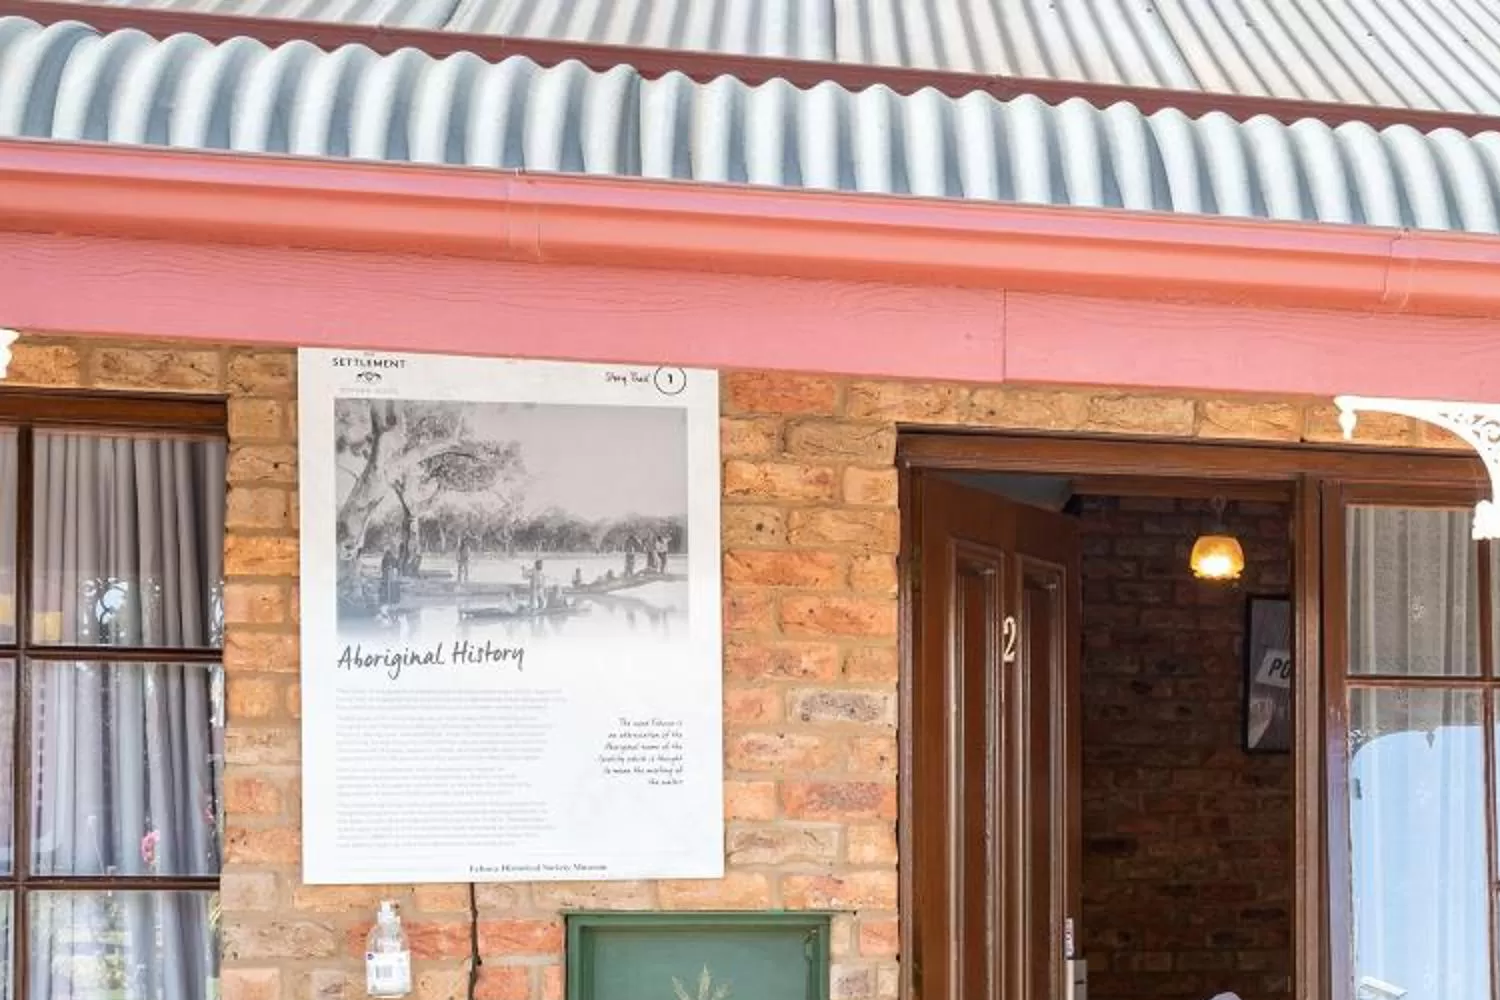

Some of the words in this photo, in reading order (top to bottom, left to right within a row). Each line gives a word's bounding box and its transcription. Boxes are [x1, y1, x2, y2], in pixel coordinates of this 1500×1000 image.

[332, 357, 407, 369] SETTLEMENT
[1003, 615, 1017, 663] 2
[337, 642, 445, 681] Aboriginal
[451, 640, 525, 672] History
